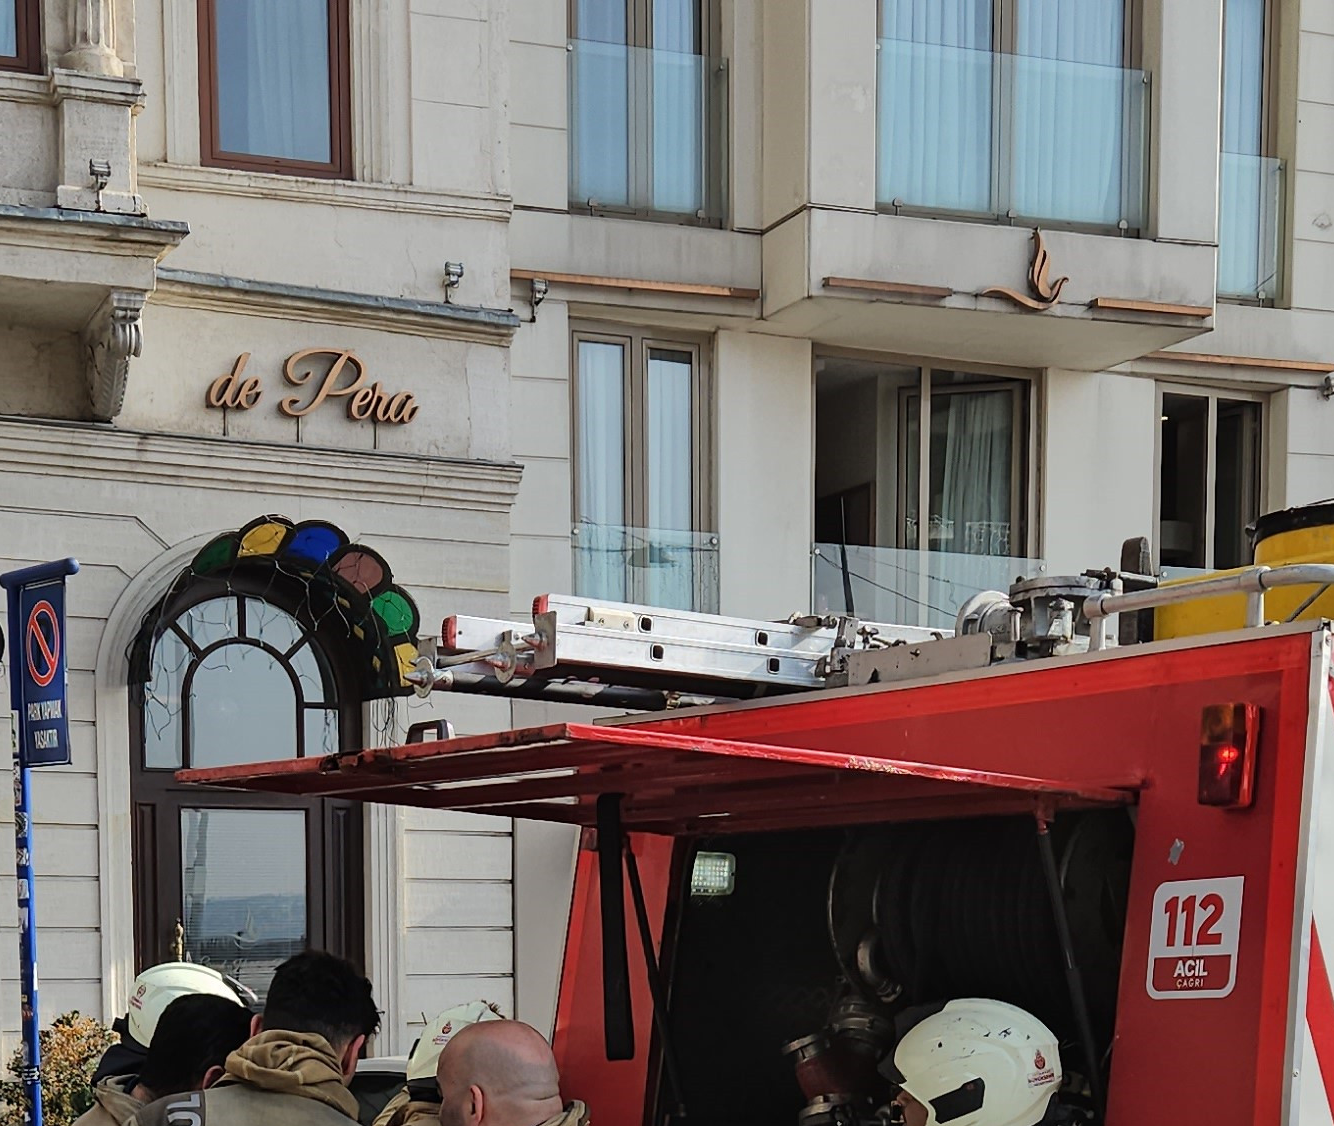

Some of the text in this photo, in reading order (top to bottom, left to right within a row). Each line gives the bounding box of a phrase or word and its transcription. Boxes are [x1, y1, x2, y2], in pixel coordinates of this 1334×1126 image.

[206, 352, 263, 409] de
[278, 347, 419, 424] Pera
[28, 702, 41, 721] PARK
[34, 729, 59, 749] YASAKTIR
[1164, 893, 1225, 948] 112
